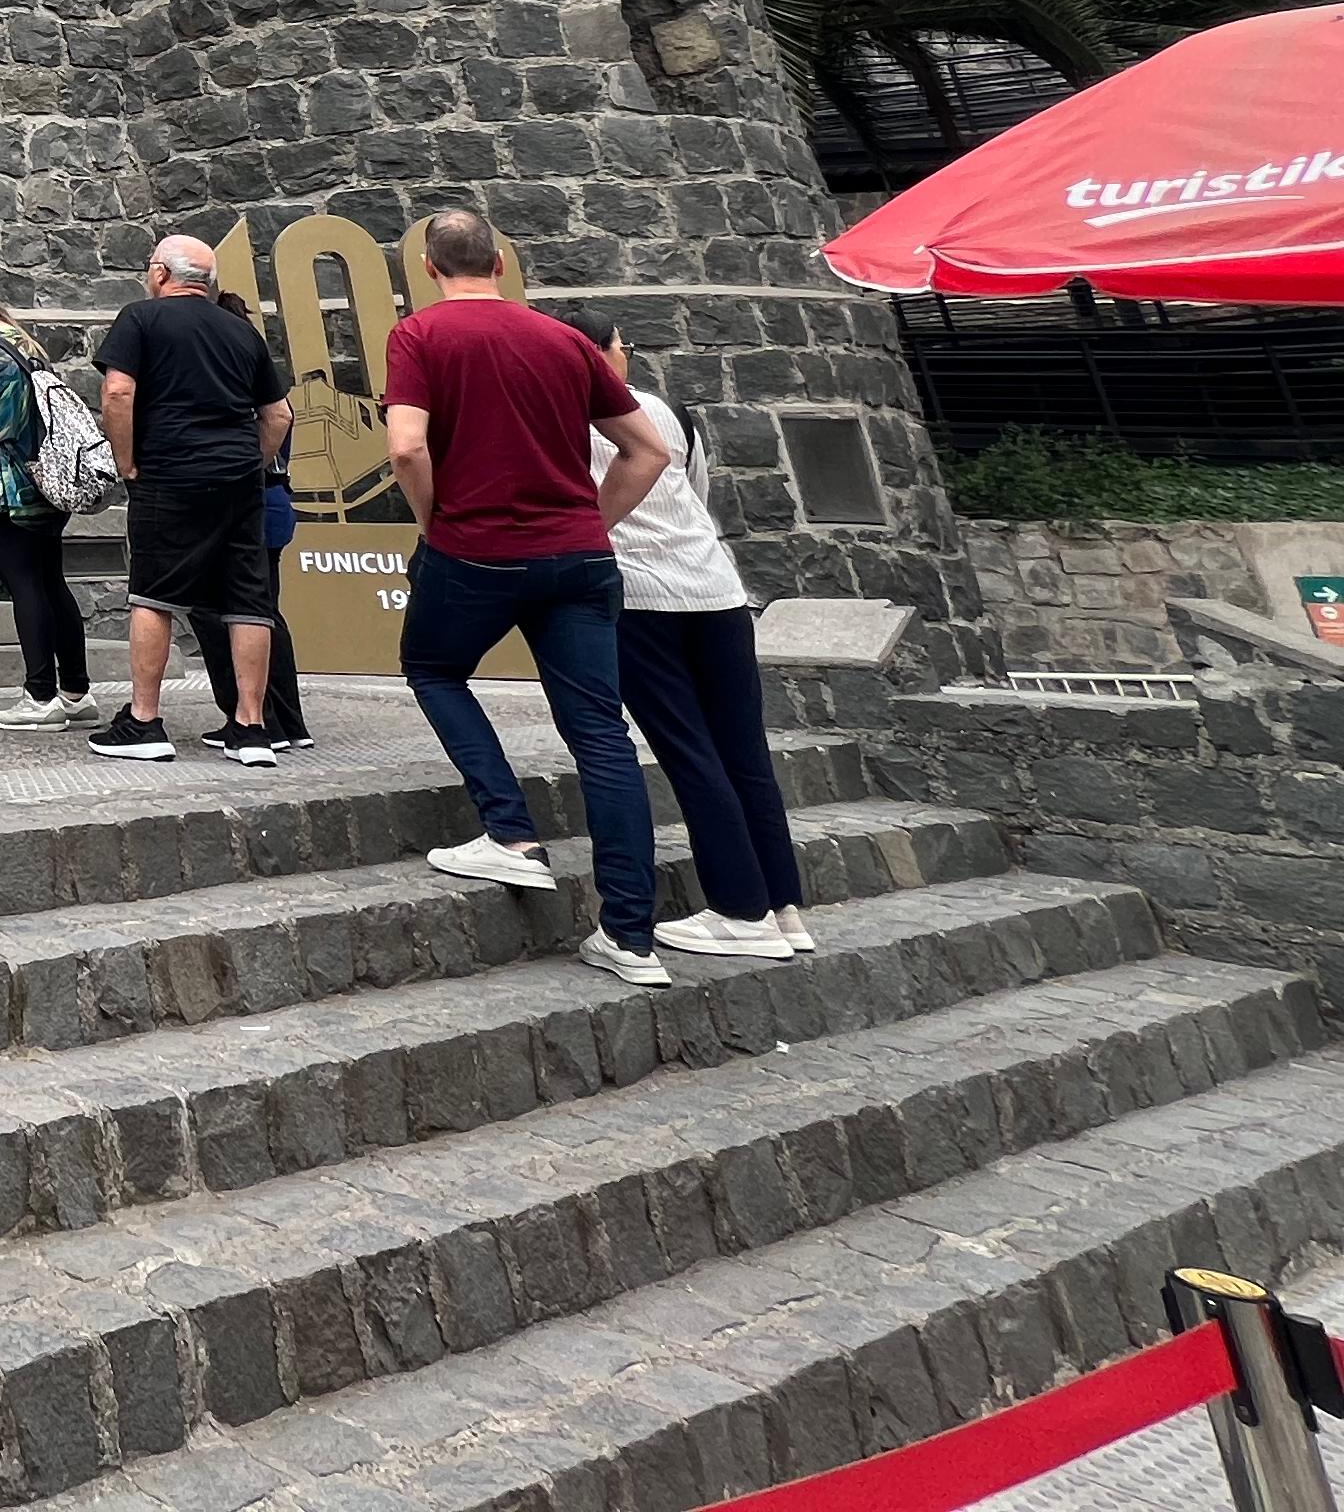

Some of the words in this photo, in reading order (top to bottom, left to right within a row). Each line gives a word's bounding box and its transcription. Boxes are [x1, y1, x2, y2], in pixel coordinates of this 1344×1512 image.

[1066, 151, 1344, 208] turistik
[214, 214, 530, 400] 10
[376, 589, 411, 610] 19
